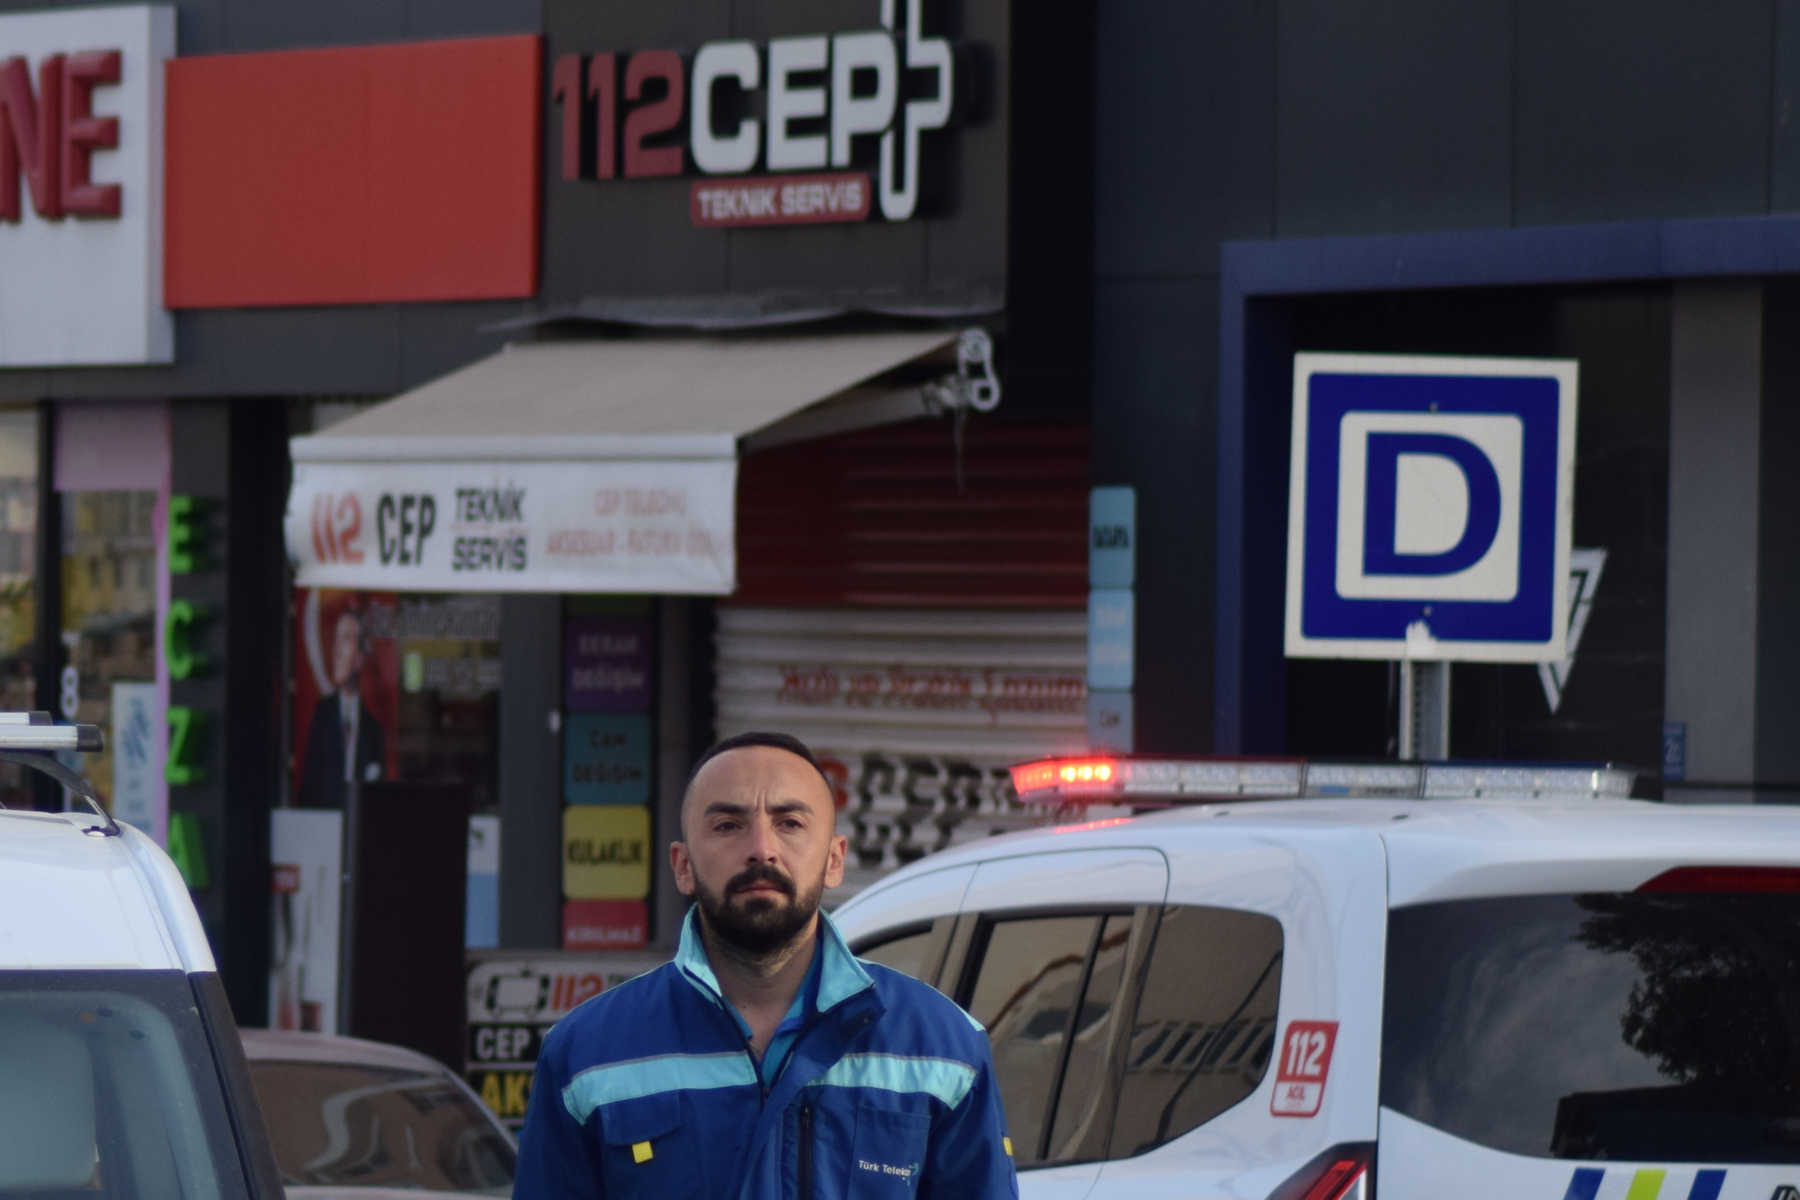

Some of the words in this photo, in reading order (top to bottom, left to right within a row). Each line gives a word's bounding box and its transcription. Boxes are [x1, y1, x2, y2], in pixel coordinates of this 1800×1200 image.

[311, 492, 365, 565] 112
[377, 491, 436, 566] CEP
[1363, 432, 1501, 577] D
[476, 1027, 531, 1060] CEP
[1285, 1031, 1327, 1076] 112
